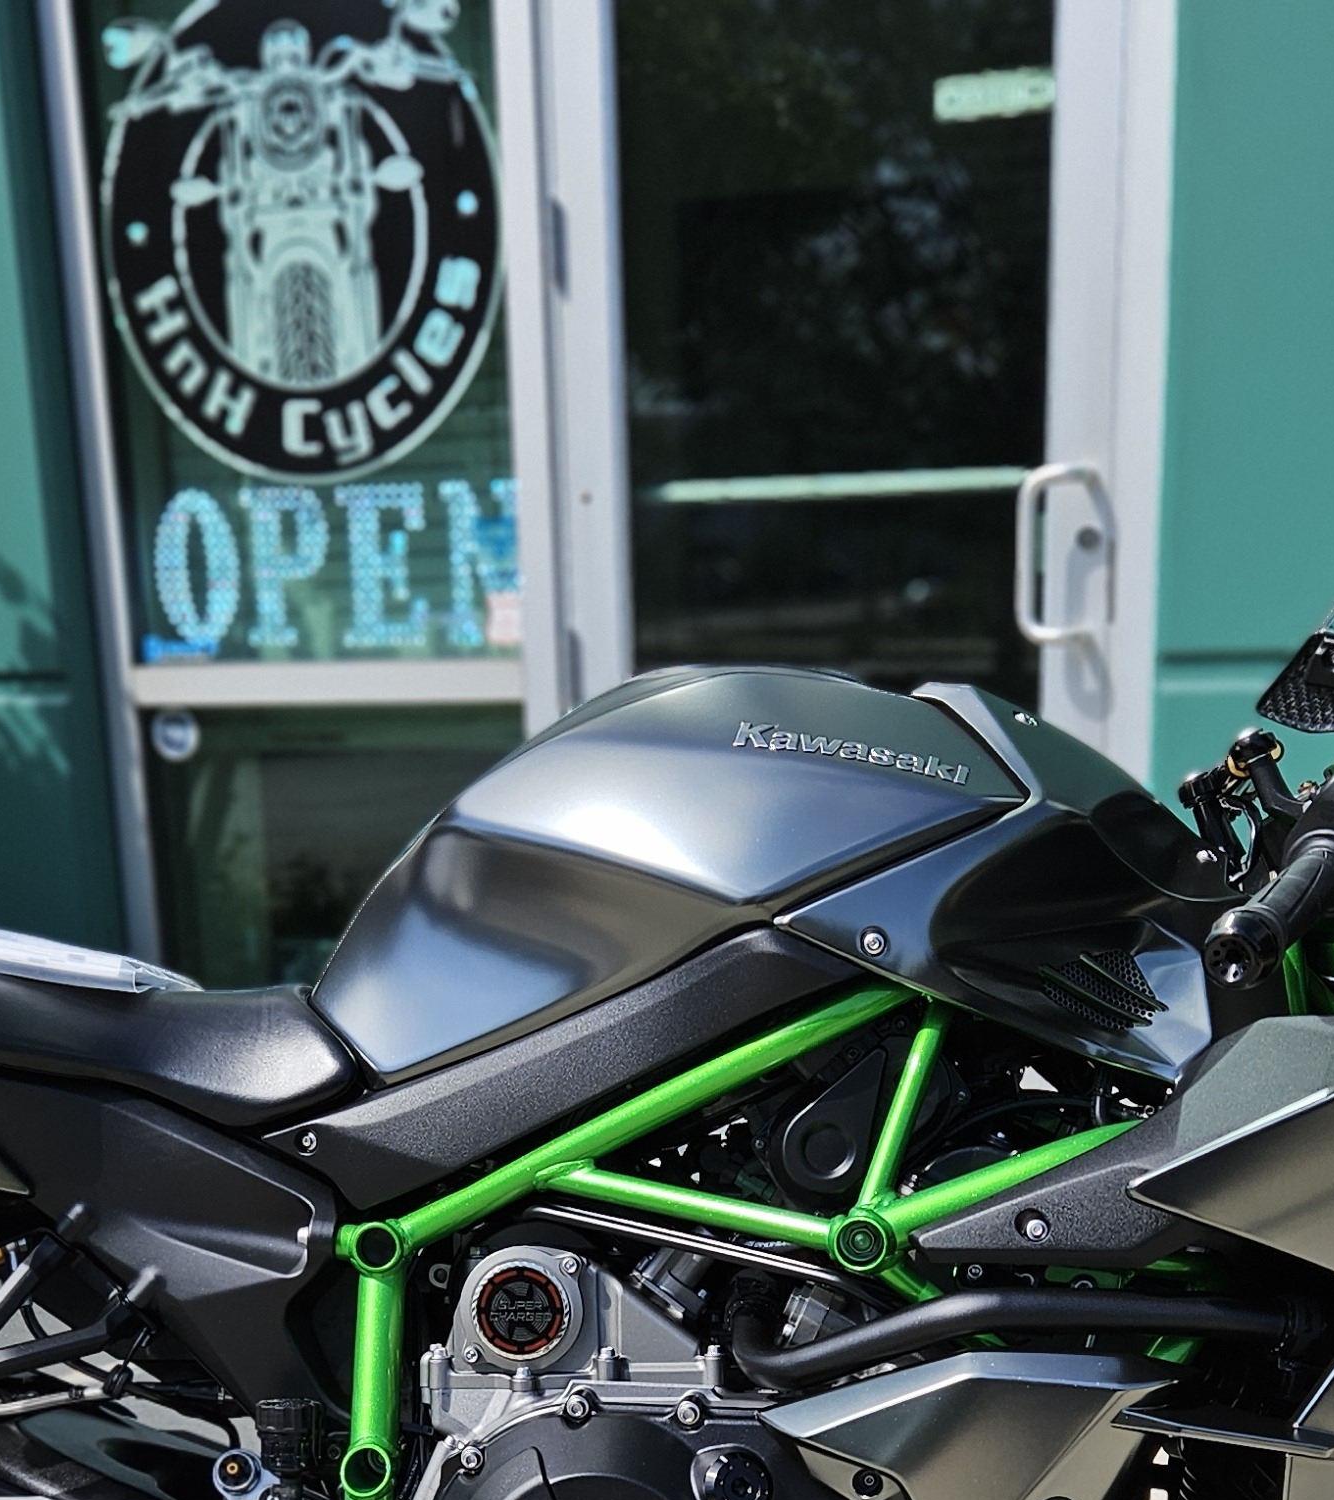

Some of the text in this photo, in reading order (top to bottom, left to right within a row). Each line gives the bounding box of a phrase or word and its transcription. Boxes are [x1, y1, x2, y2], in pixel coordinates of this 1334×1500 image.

[137, 255, 481, 464] HnH Cycles
[154, 479, 524, 649] OPEN
[732, 720, 971, 786] Kawasaki
[490, 1311, 553, 1322] CHARGED
[498, 1300, 544, 1311] SUPER
